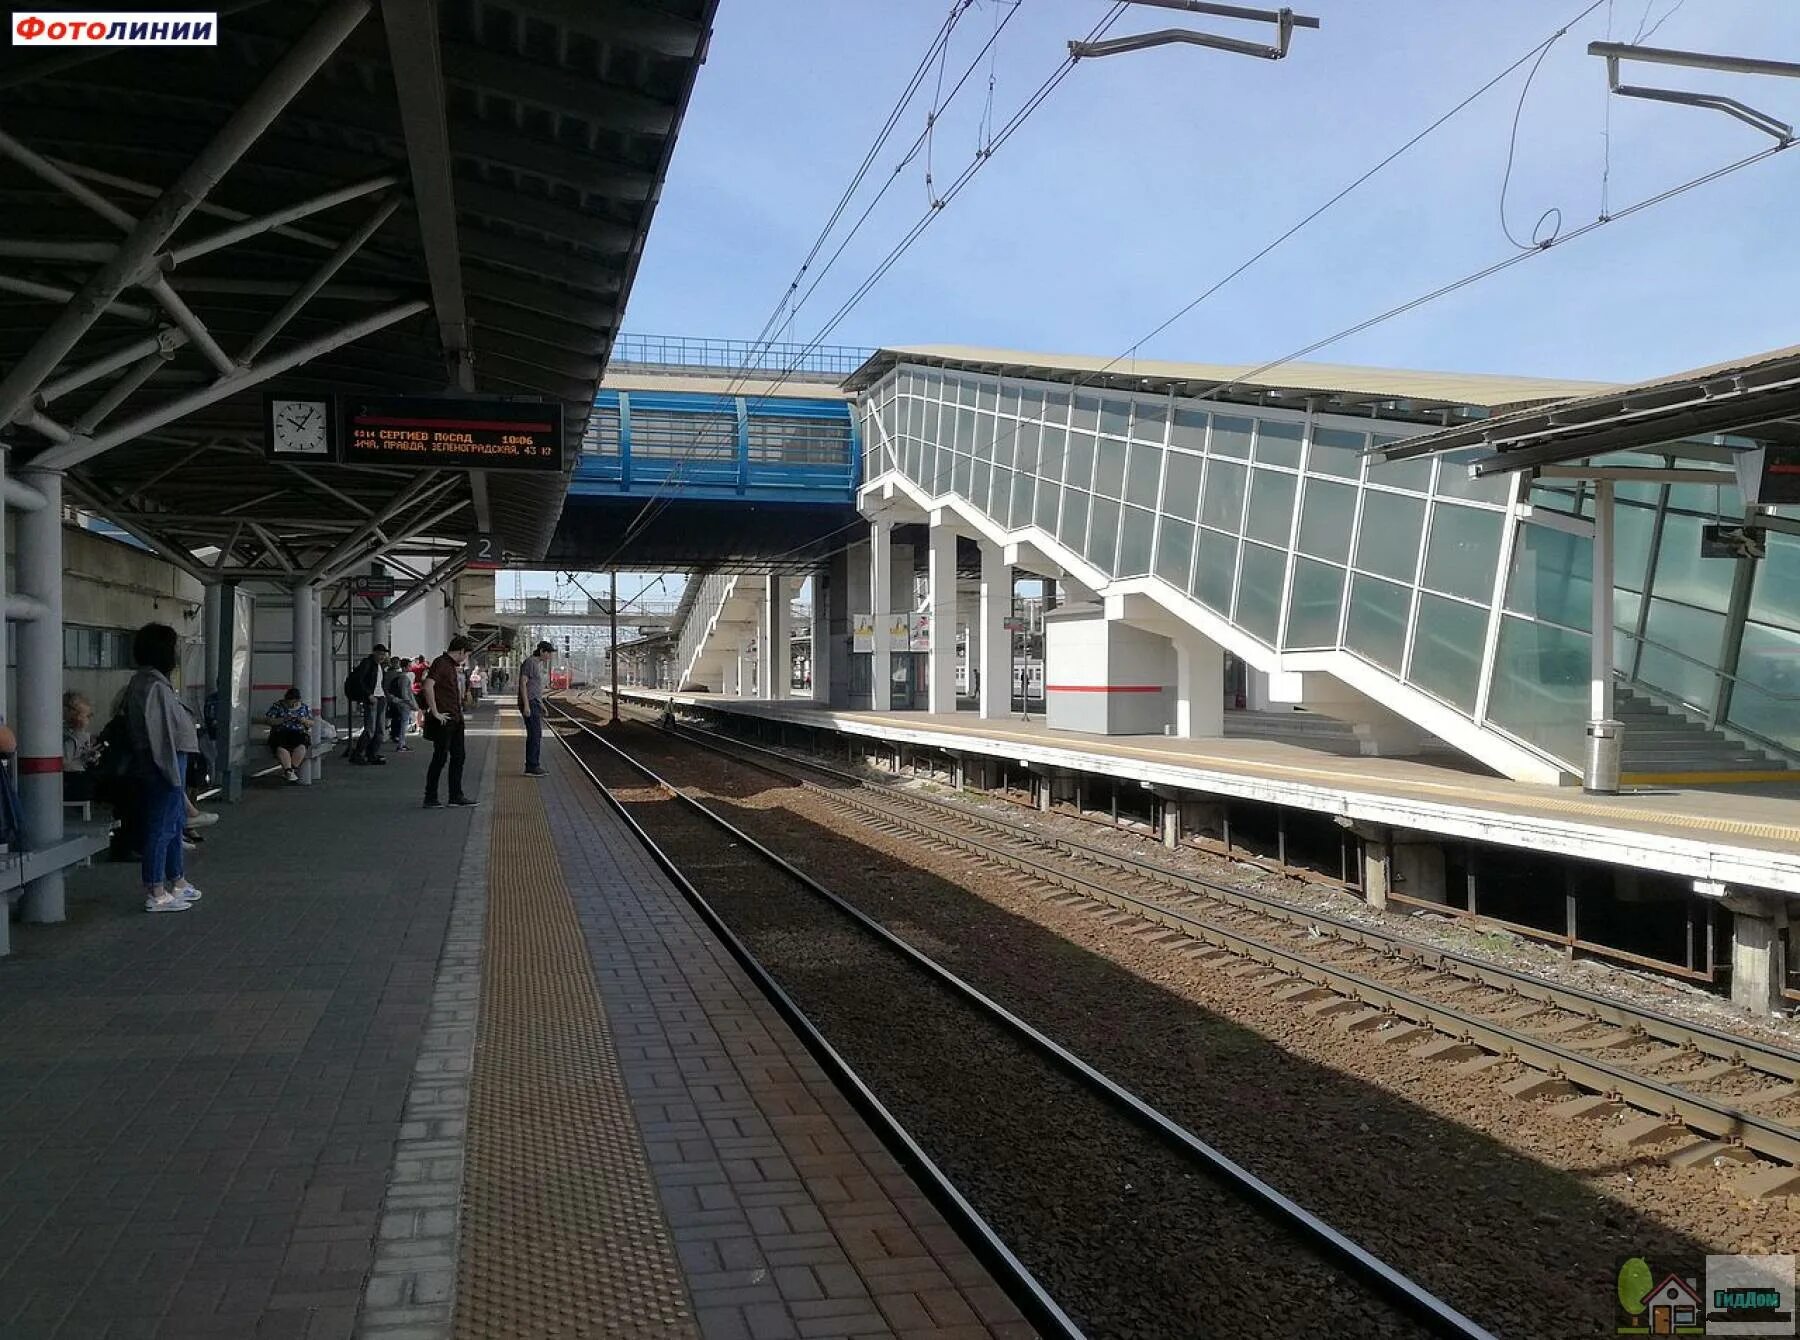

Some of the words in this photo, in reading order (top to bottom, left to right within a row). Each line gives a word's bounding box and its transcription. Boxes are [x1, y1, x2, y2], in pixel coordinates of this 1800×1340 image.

[379, 430, 429, 441] СЕРГИЕВ
[434, 432, 473, 443] ПОСАД
[502, 435, 534, 445] 10:06
[478, 539, 492, 558] 2
